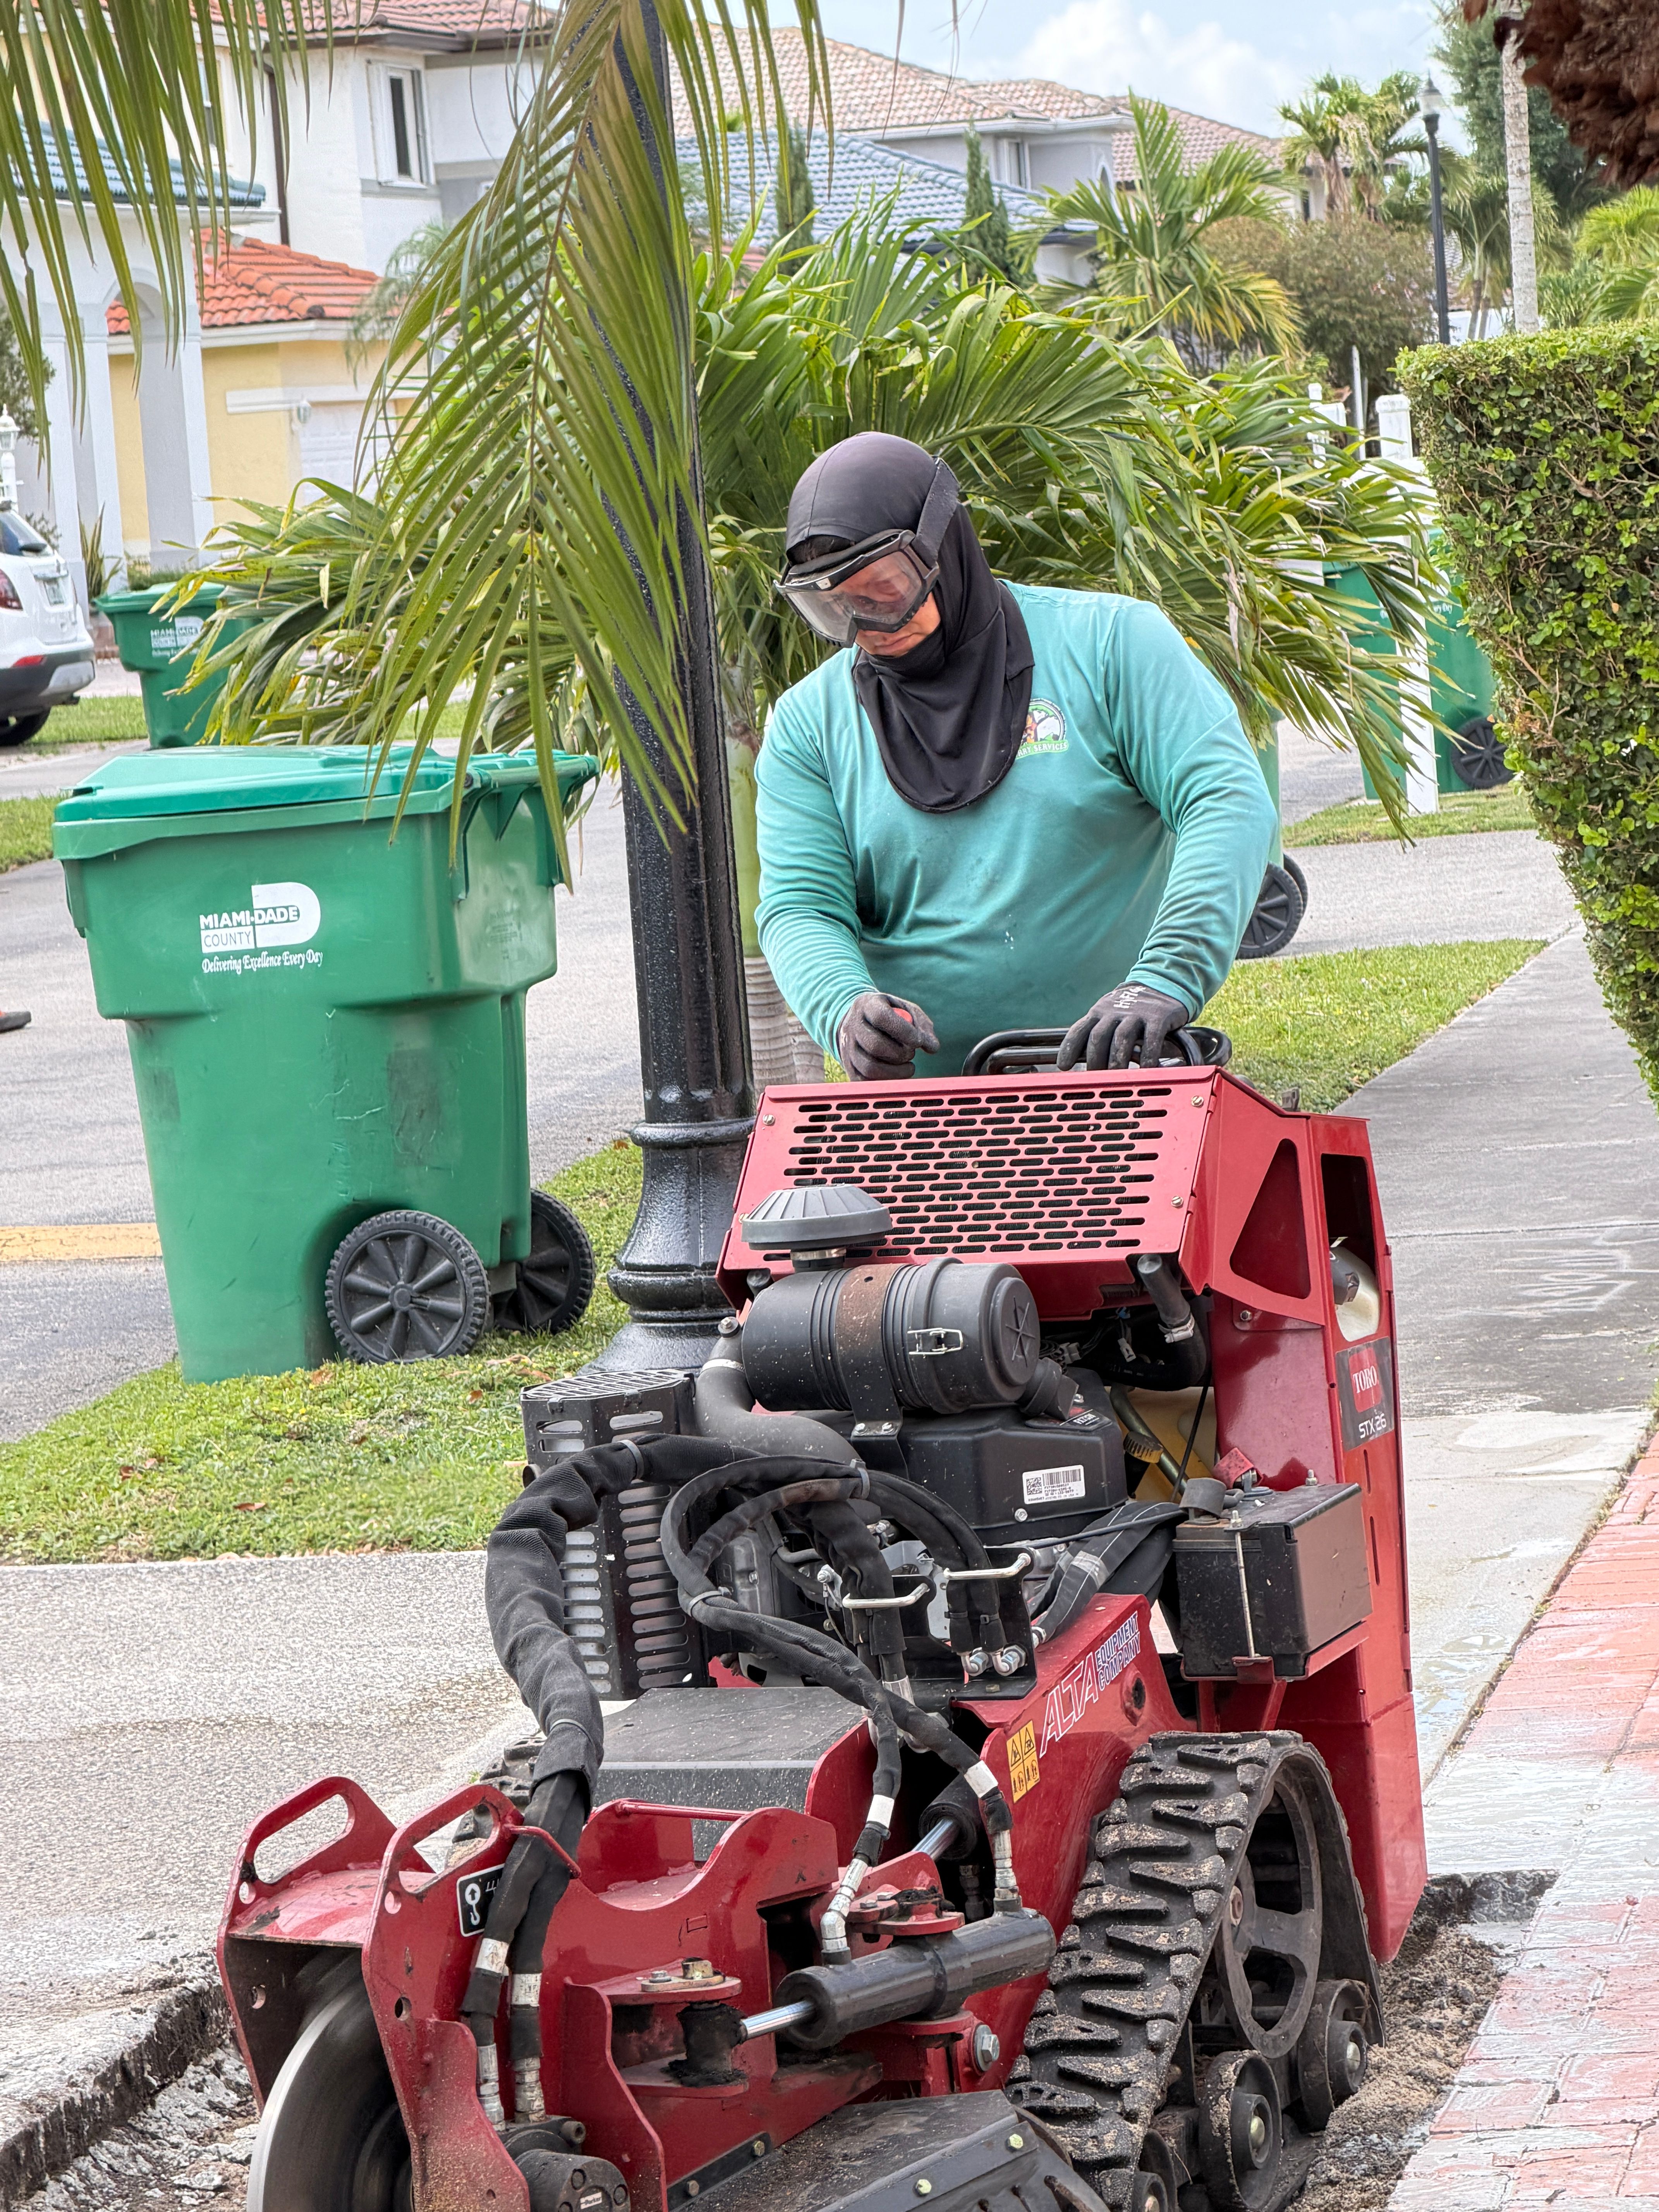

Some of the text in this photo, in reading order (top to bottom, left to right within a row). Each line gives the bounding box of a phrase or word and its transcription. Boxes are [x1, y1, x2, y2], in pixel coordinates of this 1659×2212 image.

[1033, 742, 1067, 752] SERVICES
[204, 931, 251, 948] COUNTY
[202, 949, 323, 975] Delivering Excellence Every Day
[1352, 1365, 1377, 1394] TORO
[1095, 1610, 1139, 1672] EQUIPMENT
[1098, 1631, 1141, 1691] COMPANY
[1039, 1651, 1099, 1759] ALTA
